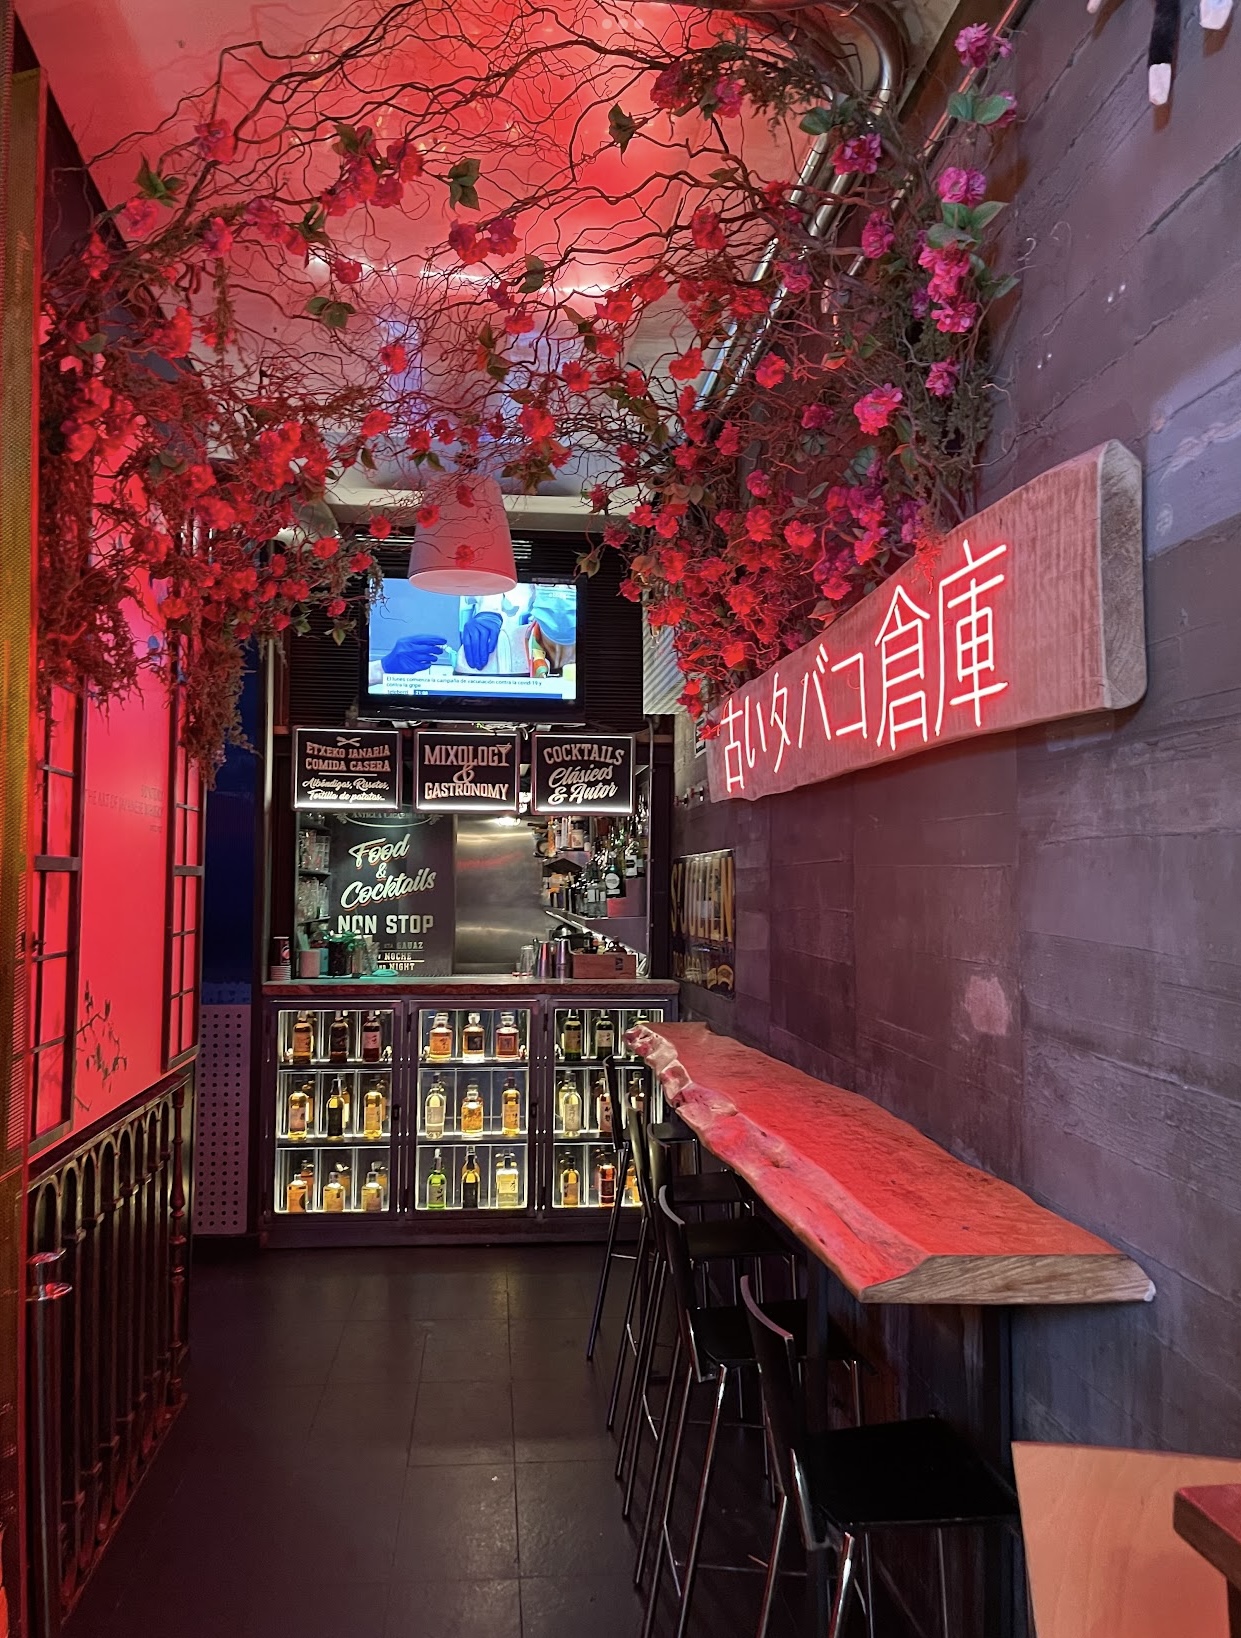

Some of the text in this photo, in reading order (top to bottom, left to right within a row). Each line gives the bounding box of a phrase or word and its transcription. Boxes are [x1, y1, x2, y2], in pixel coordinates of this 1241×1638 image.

[719, 539, 1009, 793] 古いタバコ倉庫
[306, 741, 391, 759] ETXEKO JANARIA
[424, 742, 512, 767] MIXOLOGY
[543, 743, 625, 765] COCKTAILS
[305, 757, 391, 772] COMIDA CASERA
[453, 763, 475, 784] &
[548, 763, 614, 788] Clásicos
[307, 788, 338, 801] Tortilla
[338, 791, 350, 800] de
[424, 782, 510, 801] GASTRONOMY
[547, 781, 619, 806] & Autor
[348, 833, 411, 869] Food
[375, 862, 388, 880] &
[340, 867, 437, 909] Cocktails
[337, 914, 434, 934] NON STOP
[396, 941, 424, 950] GAUAZ
[384, 952, 412, 961] NOCHE
[389, 963, 415, 971] NIGHT
